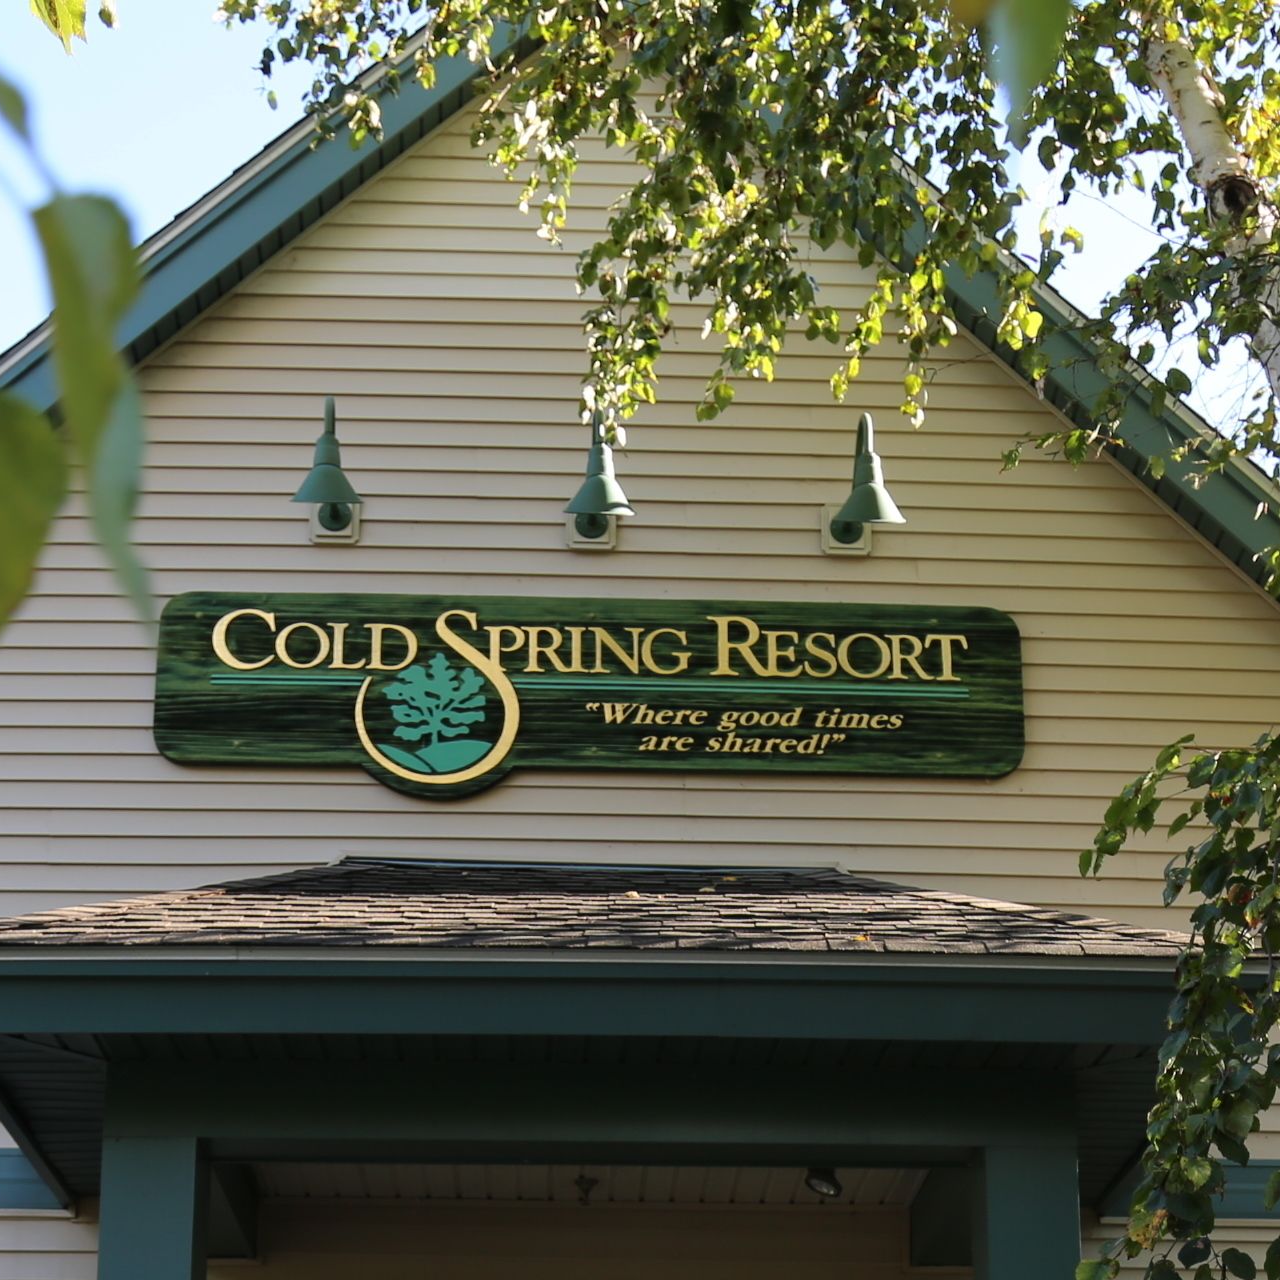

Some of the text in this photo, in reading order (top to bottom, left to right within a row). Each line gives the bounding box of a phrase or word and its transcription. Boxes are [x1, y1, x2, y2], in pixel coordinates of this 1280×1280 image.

[211, 607, 968, 682] COLD SPRING RESORT
[585, 701, 904, 732] “Where good times
[638, 732, 846, 756] are shared!”
